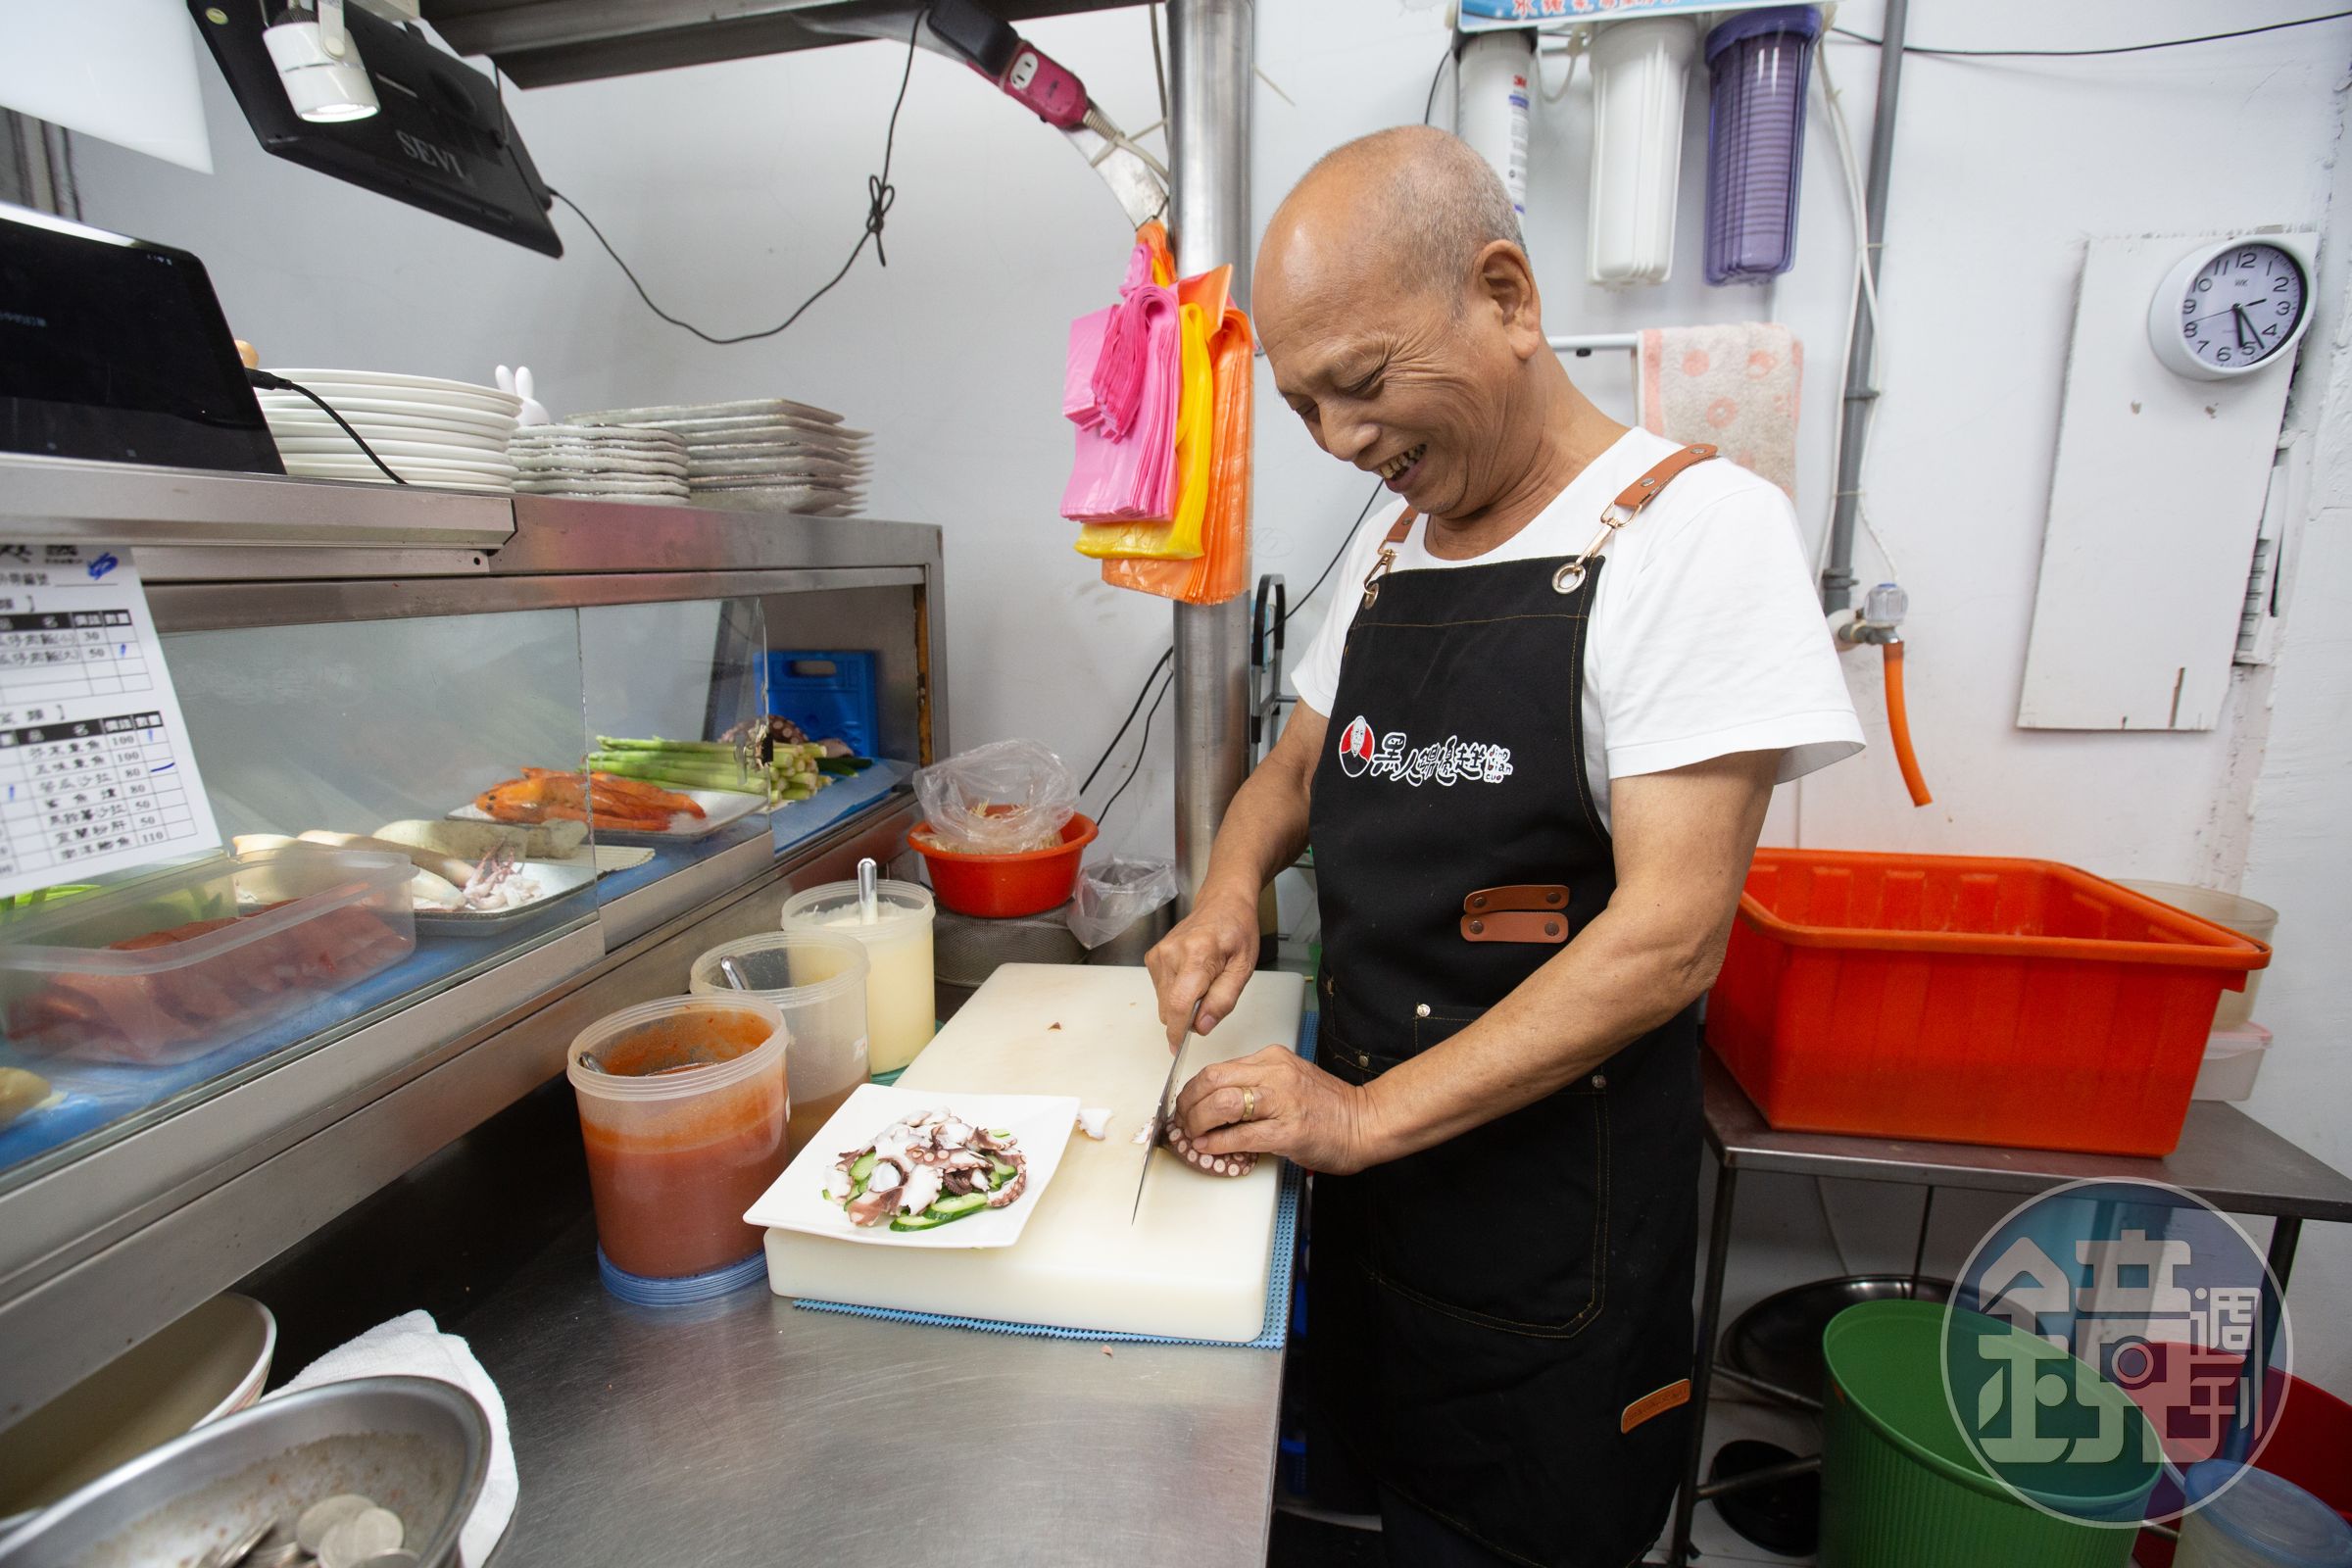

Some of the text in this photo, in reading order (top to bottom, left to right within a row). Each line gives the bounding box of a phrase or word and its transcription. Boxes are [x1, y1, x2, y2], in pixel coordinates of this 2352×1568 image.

[2214, 259, 2230, 275] 11
[2235, 253, 2257, 268] 12
[2266, 261, 2273, 275] 1
[2192, 277, 2213, 293] 10
[2273, 276, 2289, 292] 2
[2182, 299, 2196, 314] 9
[2277, 301, 2290, 316] 3
[2183, 321, 2198, 337] 8
[2262, 323, 2278, 336] 4
[2196, 341, 2210, 354] 7
[2217, 347, 2231, 362] 6
[2241, 341, 2256, 356] 5
[89, 649, 105, 659] 50
[113, 735, 134, 746] 100
[118, 751, 139, 762] 100
[1489, 747, 1508, 761] ding
[125, 768, 141, 777] 80
[1488, 759, 1511, 773] bian
[1486, 773, 1502, 782] cuo
[130, 785, 146, 794] 80
[135, 801, 151, 810] 50
[140, 816, 156, 826] 50
[142, 832, 164, 844] 110
